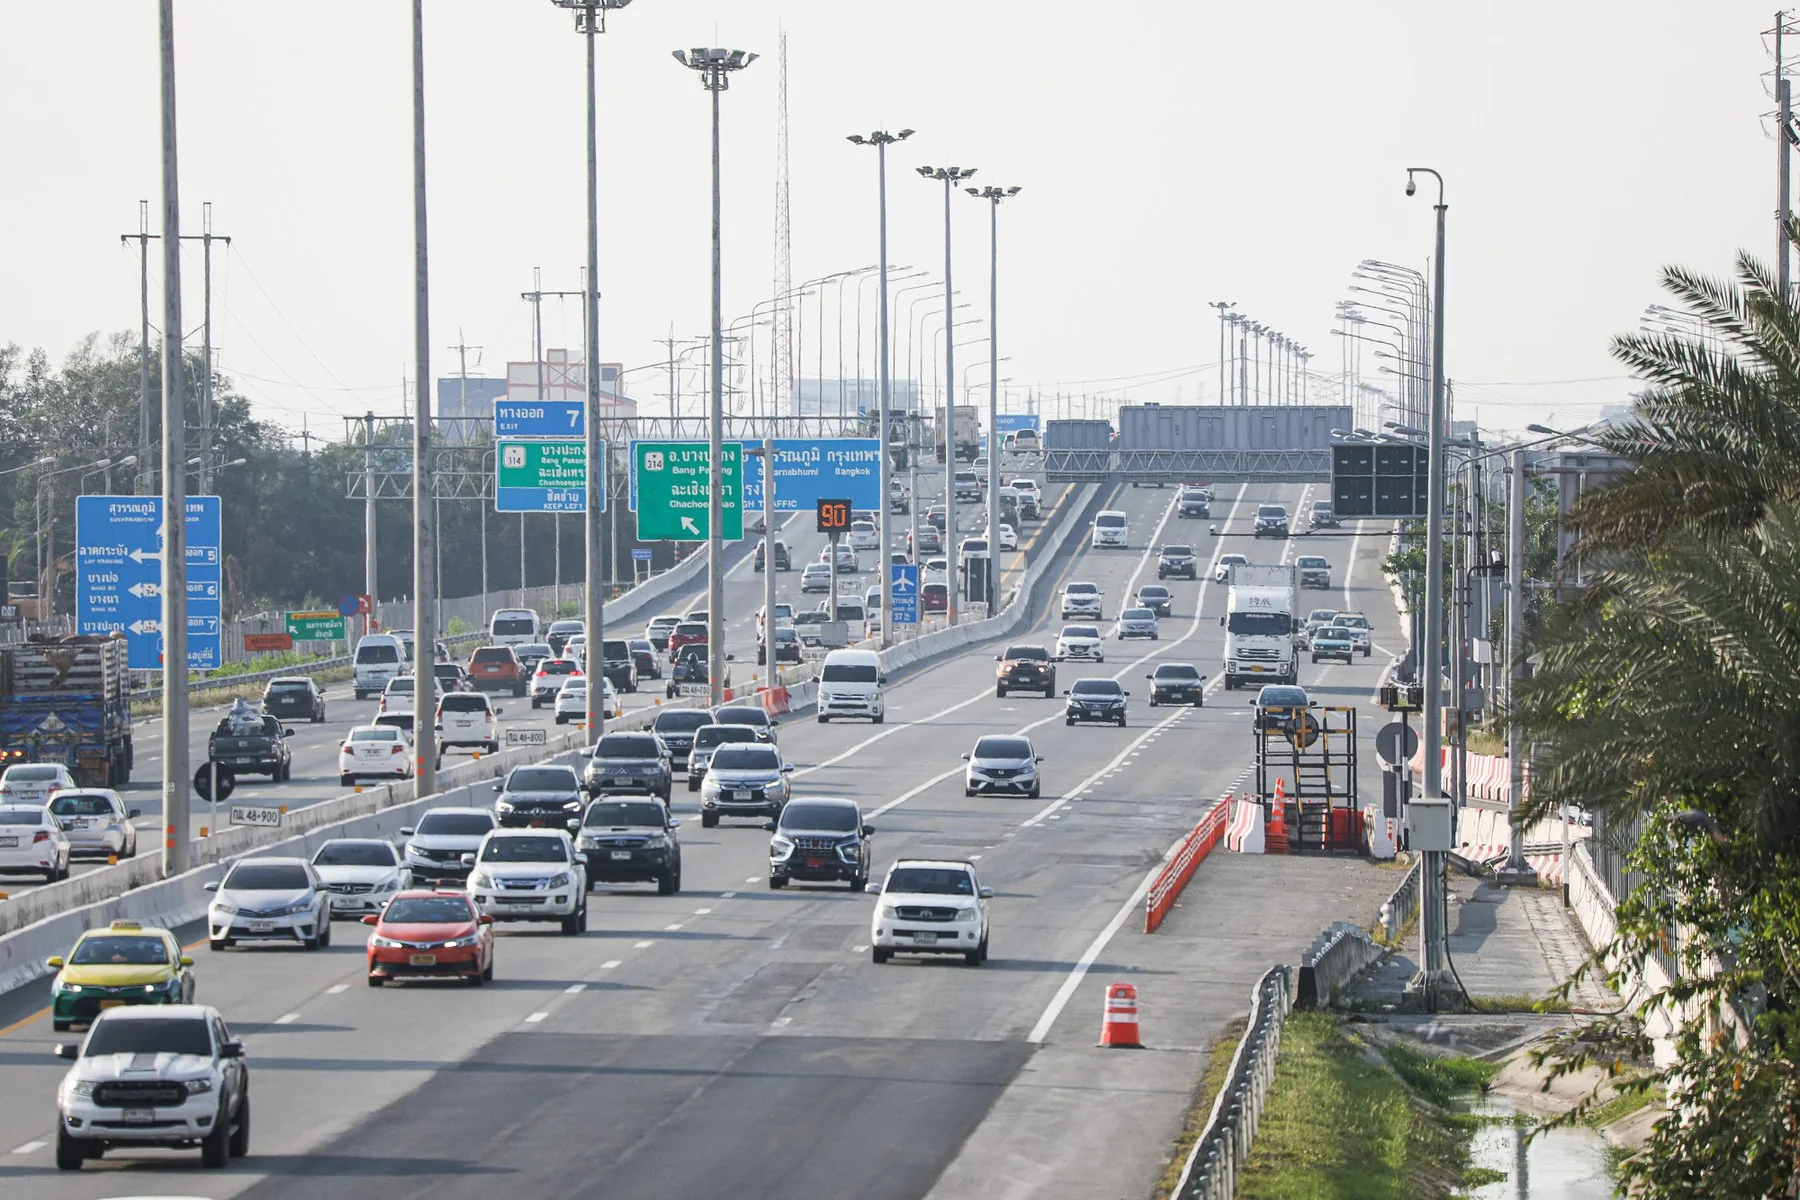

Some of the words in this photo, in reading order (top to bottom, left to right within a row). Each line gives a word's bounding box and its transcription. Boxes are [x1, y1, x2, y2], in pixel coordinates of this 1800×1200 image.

[499, 408, 545, 419] ทางออก
[566, 409, 580, 428] 7
[1029, 418, 1037, 429] 7
[507, 456, 522, 465] 314
[541, 457, 559, 466] Bang
[647, 460, 662, 469] 314
[538, 464, 587, 478] ฉะเชิงเทร
[672, 466, 696, 475] Bang
[698, 466, 733, 476] Pang
[757, 468, 819, 476] Sarnabhumi
[834, 467, 871, 477] Bangkok
[671, 480, 732, 496] ฉะเชิงเรา
[546, 488, 579, 502] ชิดซ้าย
[109, 501, 156, 516] สุวรรณภูมิ
[543, 502, 562, 510] KEEP
[564, 502, 583, 510] LEFT
[758, 499, 798, 508] TAFFIC
[821, 503, 847, 527] 90
[79, 543, 128, 557] ลาดกระบัง
[207, 550, 216, 561] 5
[87, 570, 119, 583] บางบ่อ
[206, 585, 216, 596] 6
[89, 595, 119, 604] บางนา
[1, 606, 17, 617] CAT
[83, 620, 125, 632] บางปะกง
[207, 619, 216, 631] 7
[246, 810, 278, 823] 48+900
